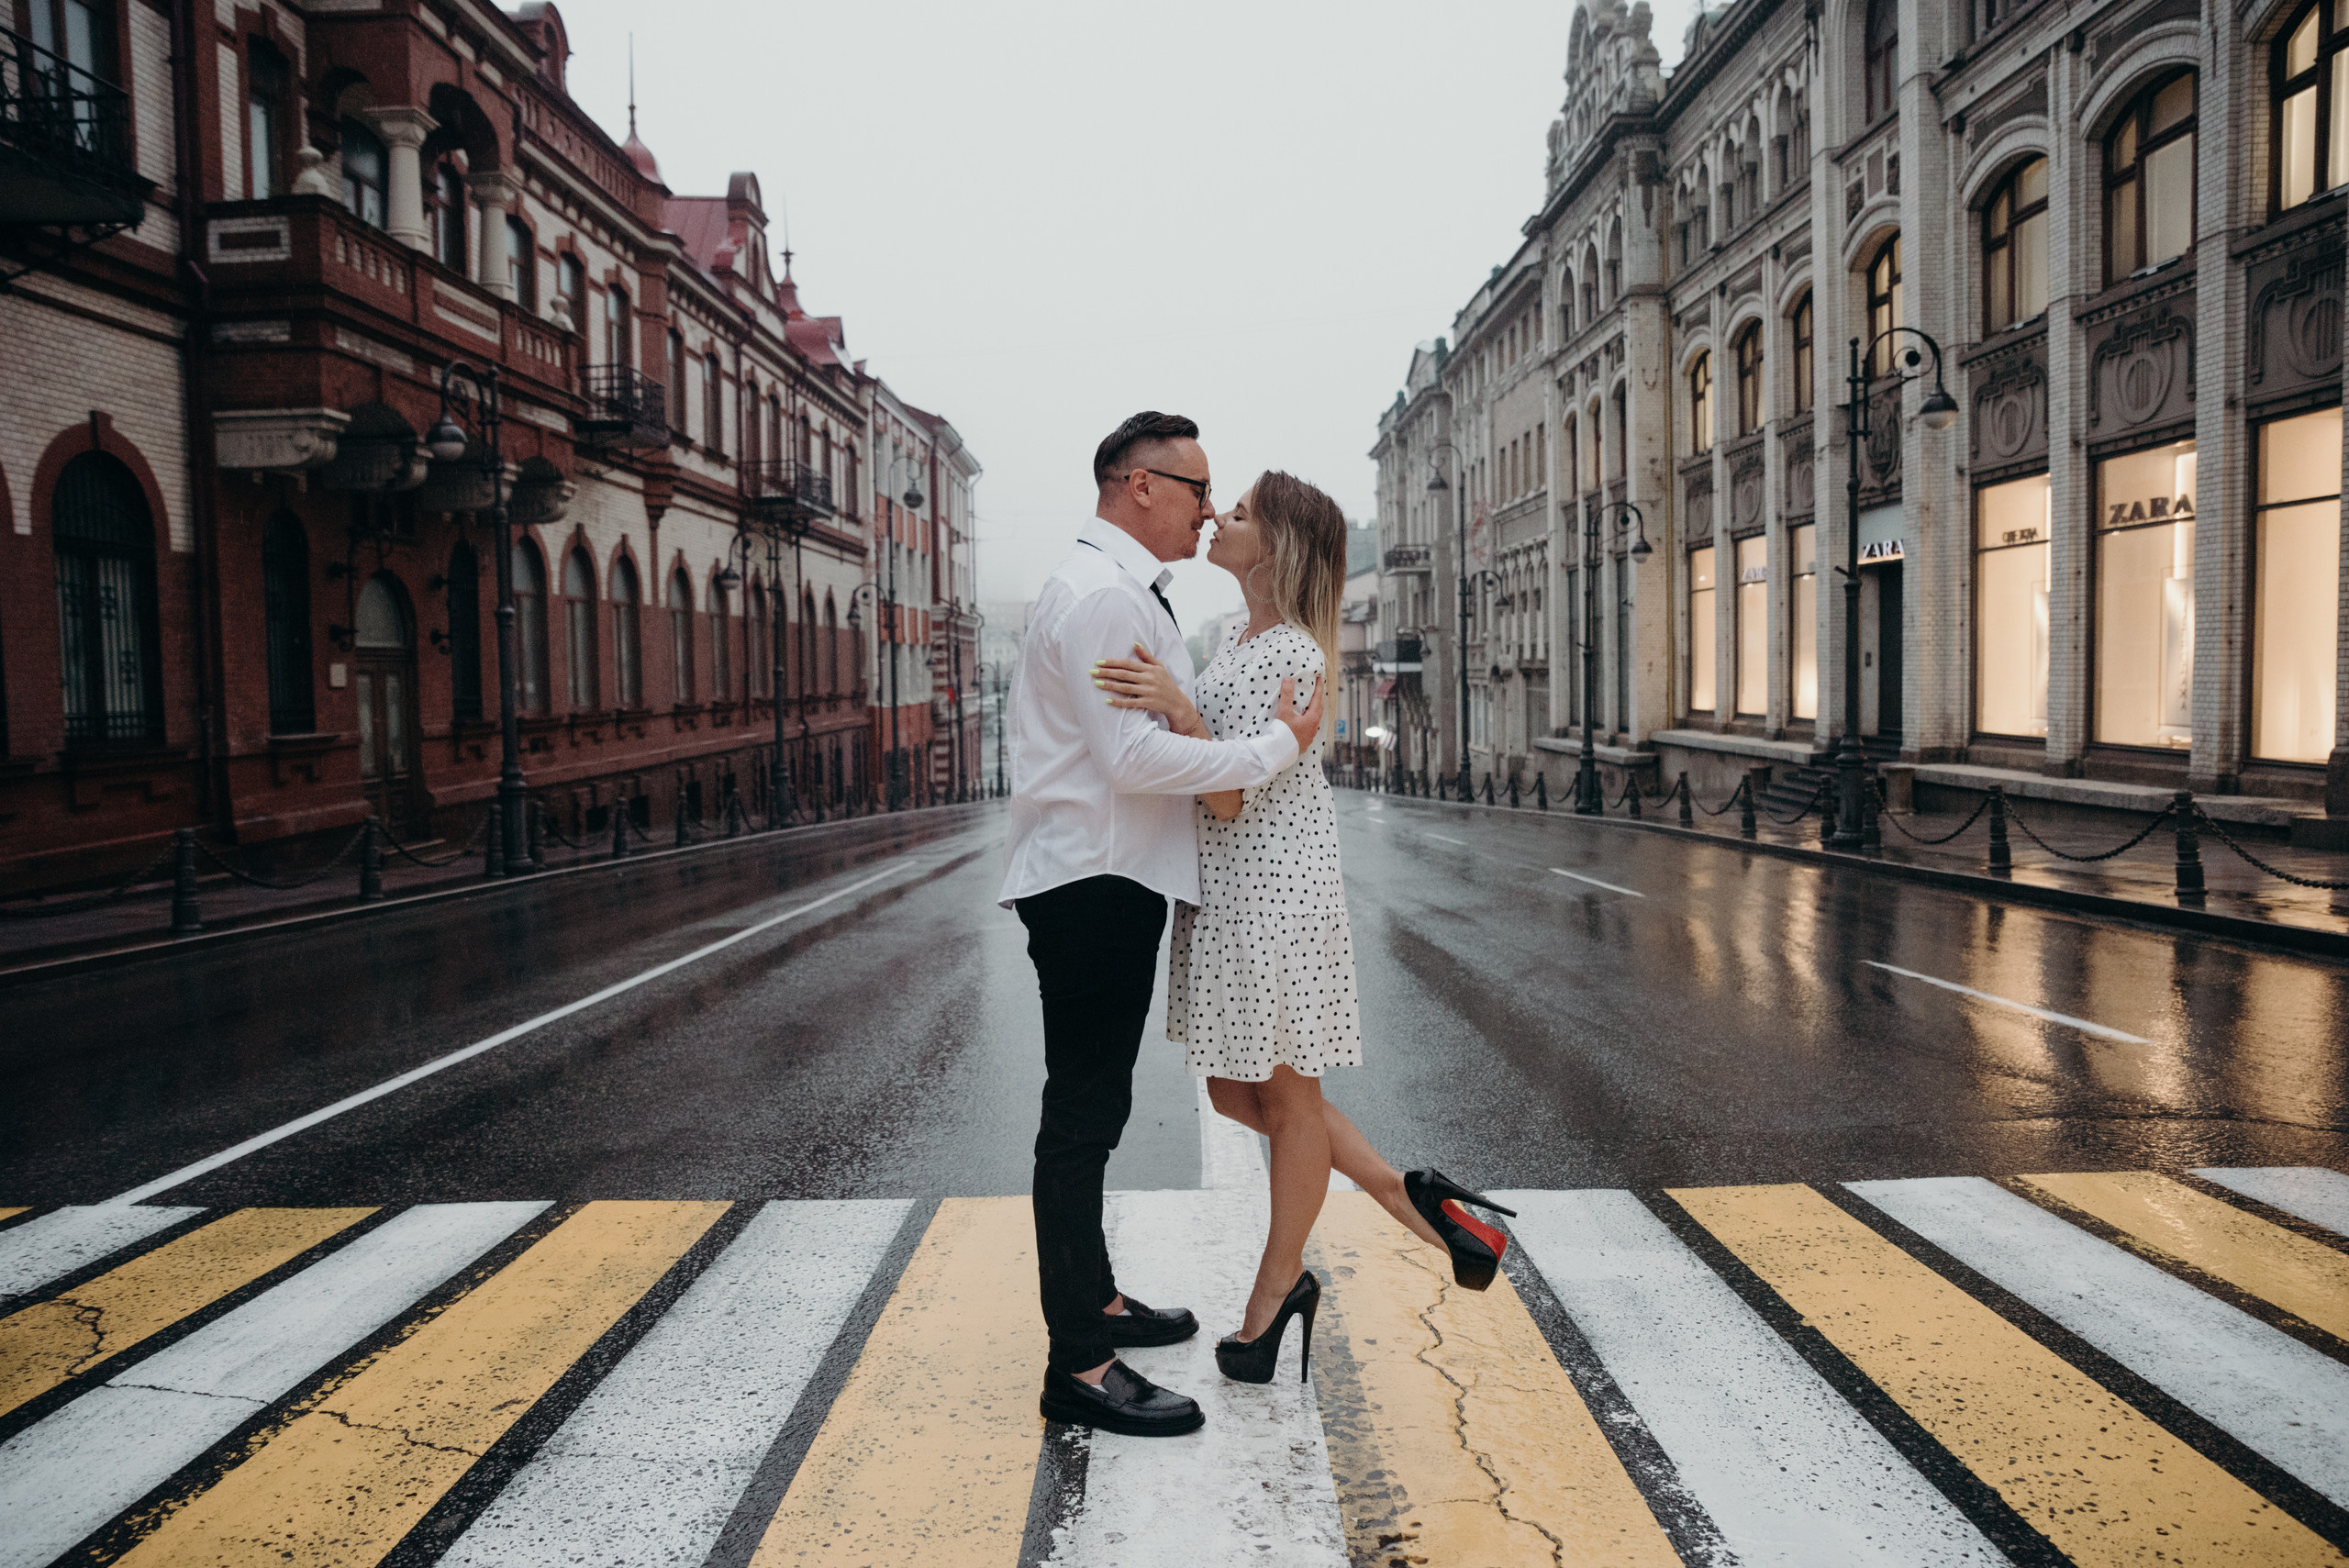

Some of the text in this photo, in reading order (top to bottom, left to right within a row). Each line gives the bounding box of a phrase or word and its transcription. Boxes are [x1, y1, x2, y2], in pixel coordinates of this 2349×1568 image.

[2109, 494, 2194, 524] ZARA
[1863, 539, 1905, 558] ZARA
[1742, 565, 1765, 581] ZAR
